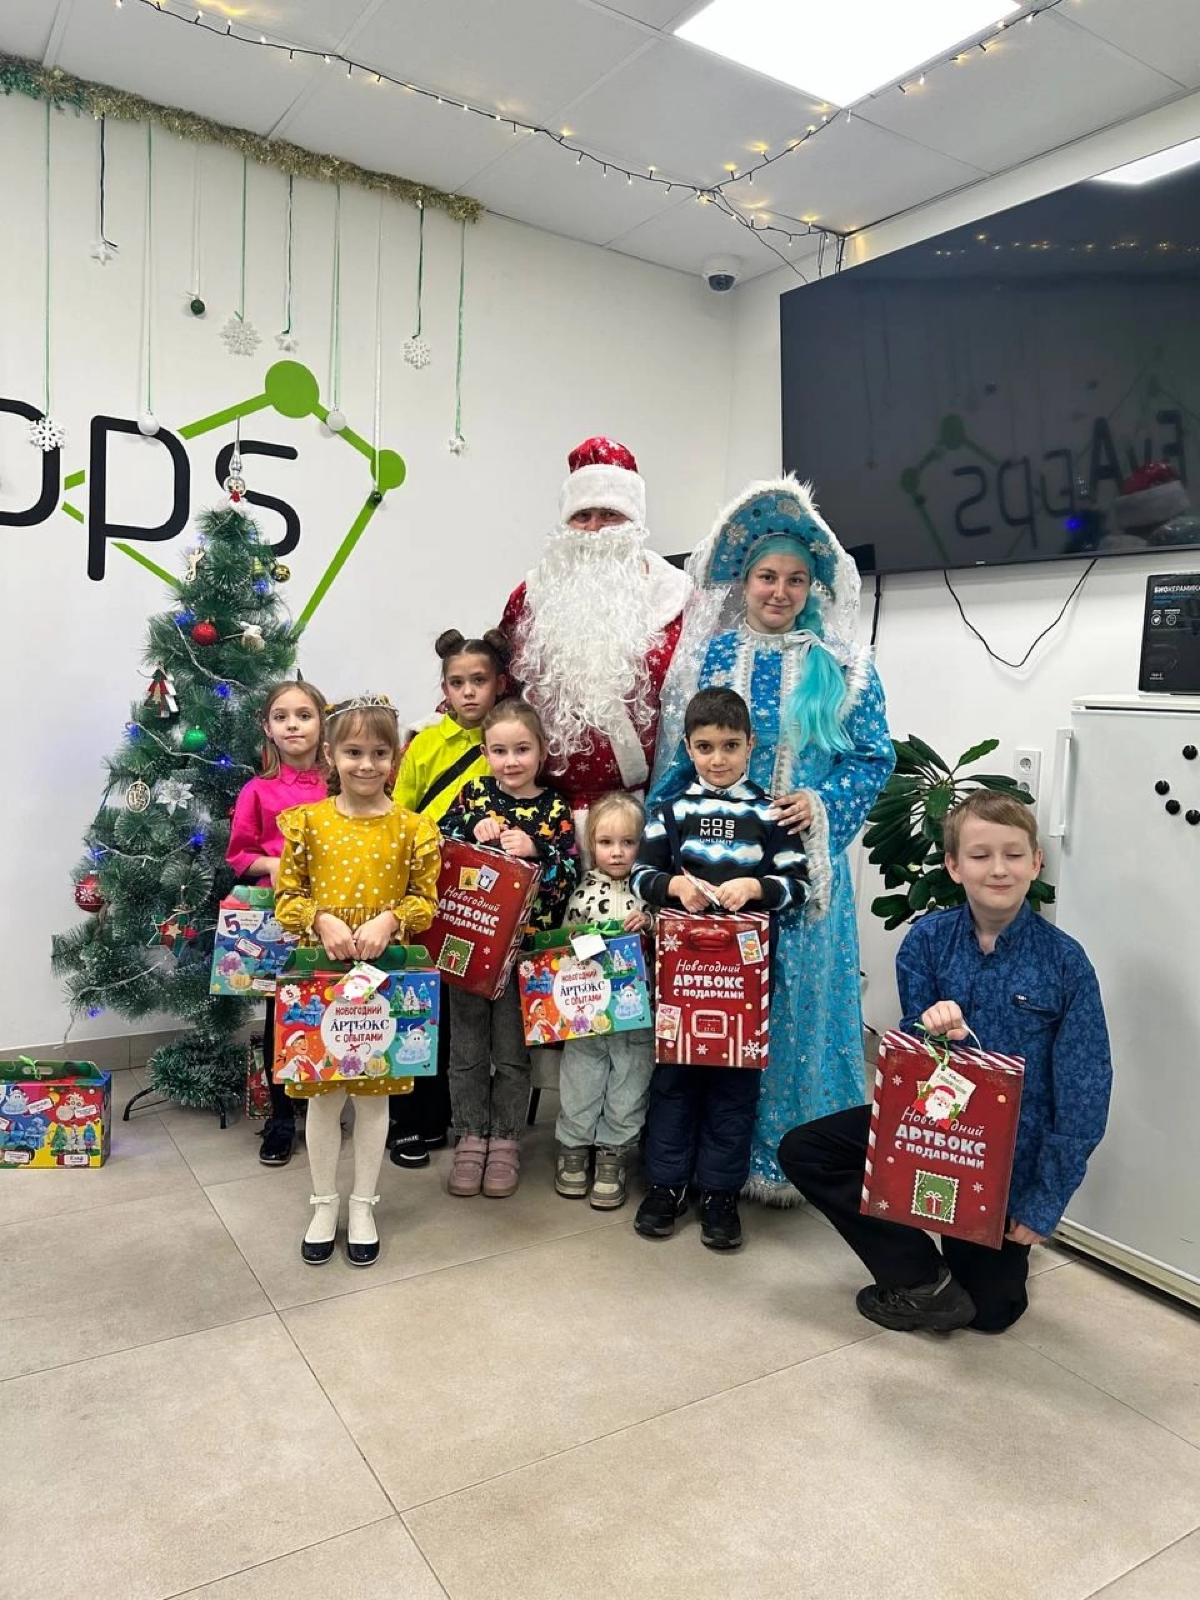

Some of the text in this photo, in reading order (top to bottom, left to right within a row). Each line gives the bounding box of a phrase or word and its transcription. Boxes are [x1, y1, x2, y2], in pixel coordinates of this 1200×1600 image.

[700, 818, 735, 829] COS
[700, 828, 735, 839] MOS
[443, 885, 500, 912] Новогодний
[439, 898, 500, 928] АРТБОКС
[224, 914, 240, 935] 5
[443, 913, 496, 937] ПОДАРКАМИ
[675, 959, 741, 973] Новогодний
[561, 969, 597, 982] НОВОГОДНИЙ
[673, 974, 745, 989] АРТБОКС
[286, 989, 294, 998] 5
[560, 981, 605, 997] АРТБОКС
[682, 989, 745, 1000] ПОДАРКАМИ
[571, 994, 601, 1004] ОПЫТАМИ
[335, 1004, 382, 1016] НОВОГОДНИЙ
[330, 1019, 389, 1035] АРТБОКС
[344, 1033, 383, 1043] ОПЫТАМИ
[895, 1124, 986, 1157] АРТБОКС
[906, 1142, 985, 1170] ПОДАРКАМИ
